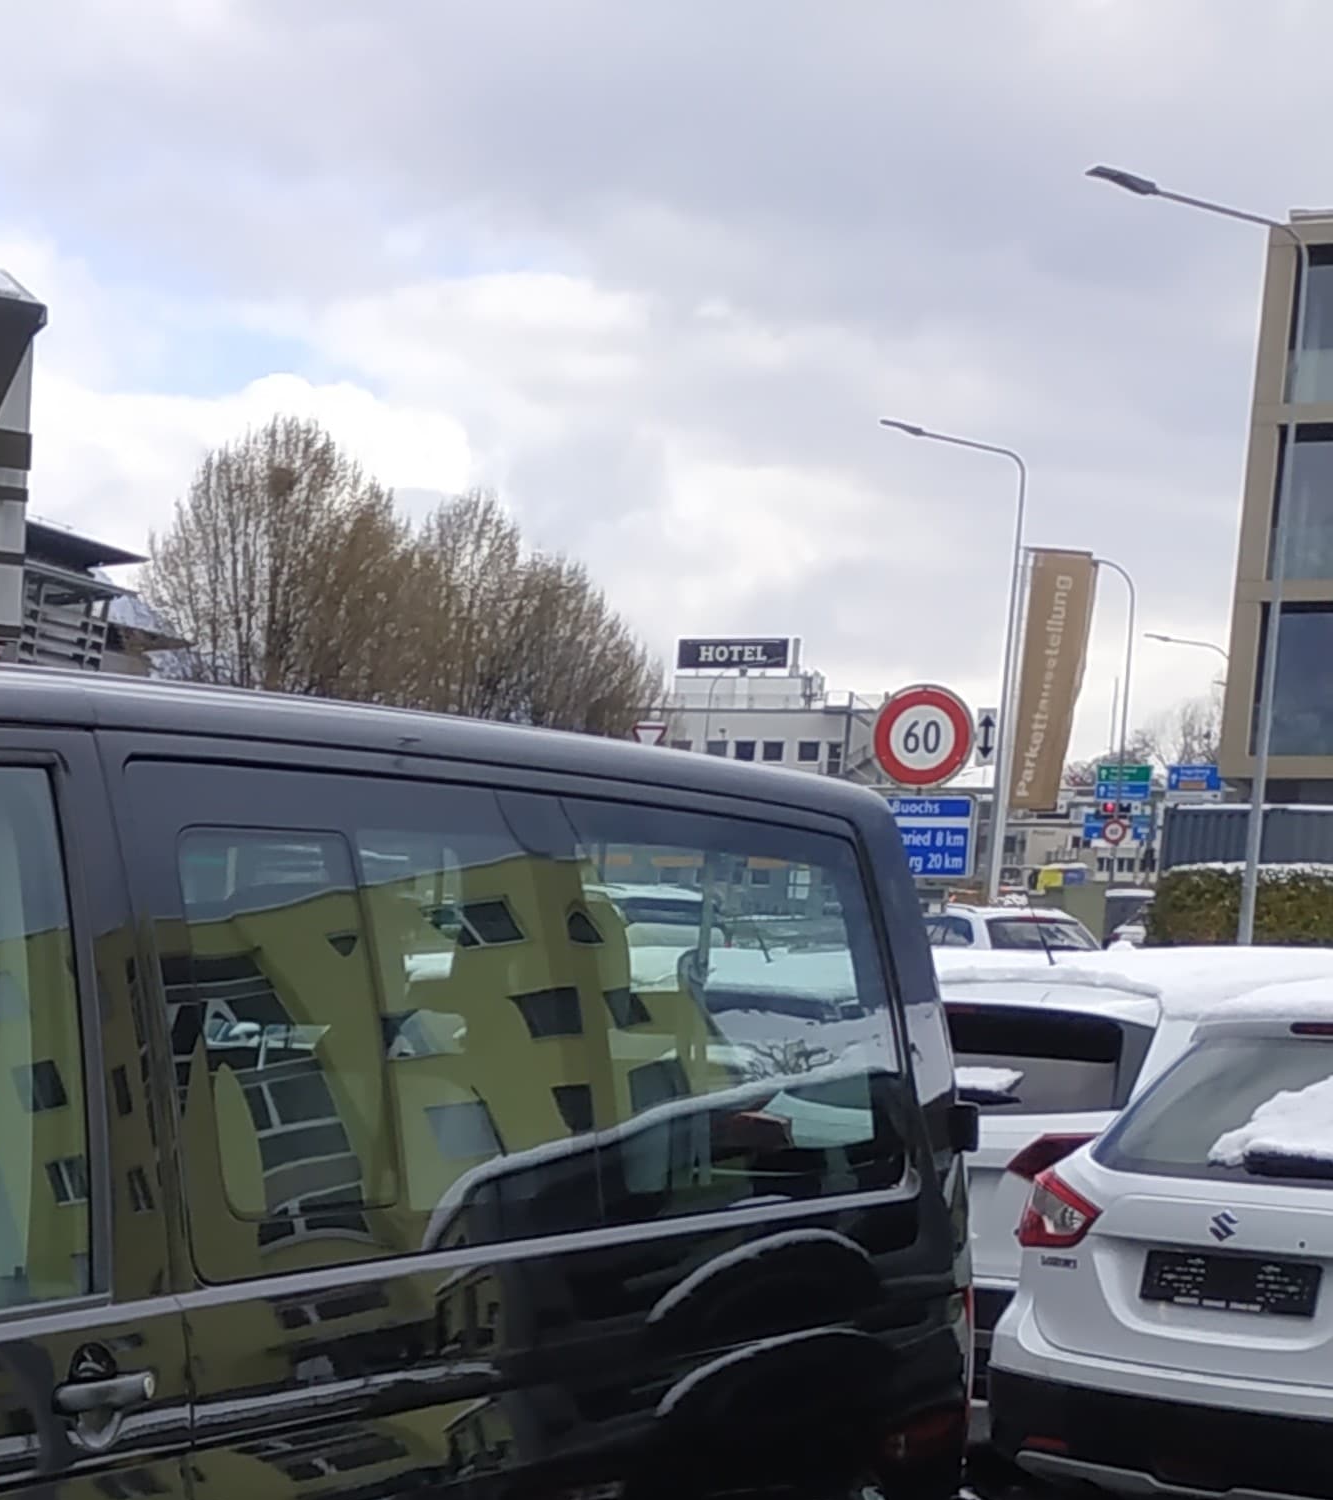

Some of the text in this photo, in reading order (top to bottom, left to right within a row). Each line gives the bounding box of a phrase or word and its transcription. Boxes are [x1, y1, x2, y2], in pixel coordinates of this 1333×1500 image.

[698, 645, 767, 662] HOTEL
[903, 720, 941, 754] 60
[893, 800, 940, 814] Buochs
[901, 830, 965, 847] nried 8 km
[927, 853, 942, 869] 20
[944, 852, 963, 869] km
